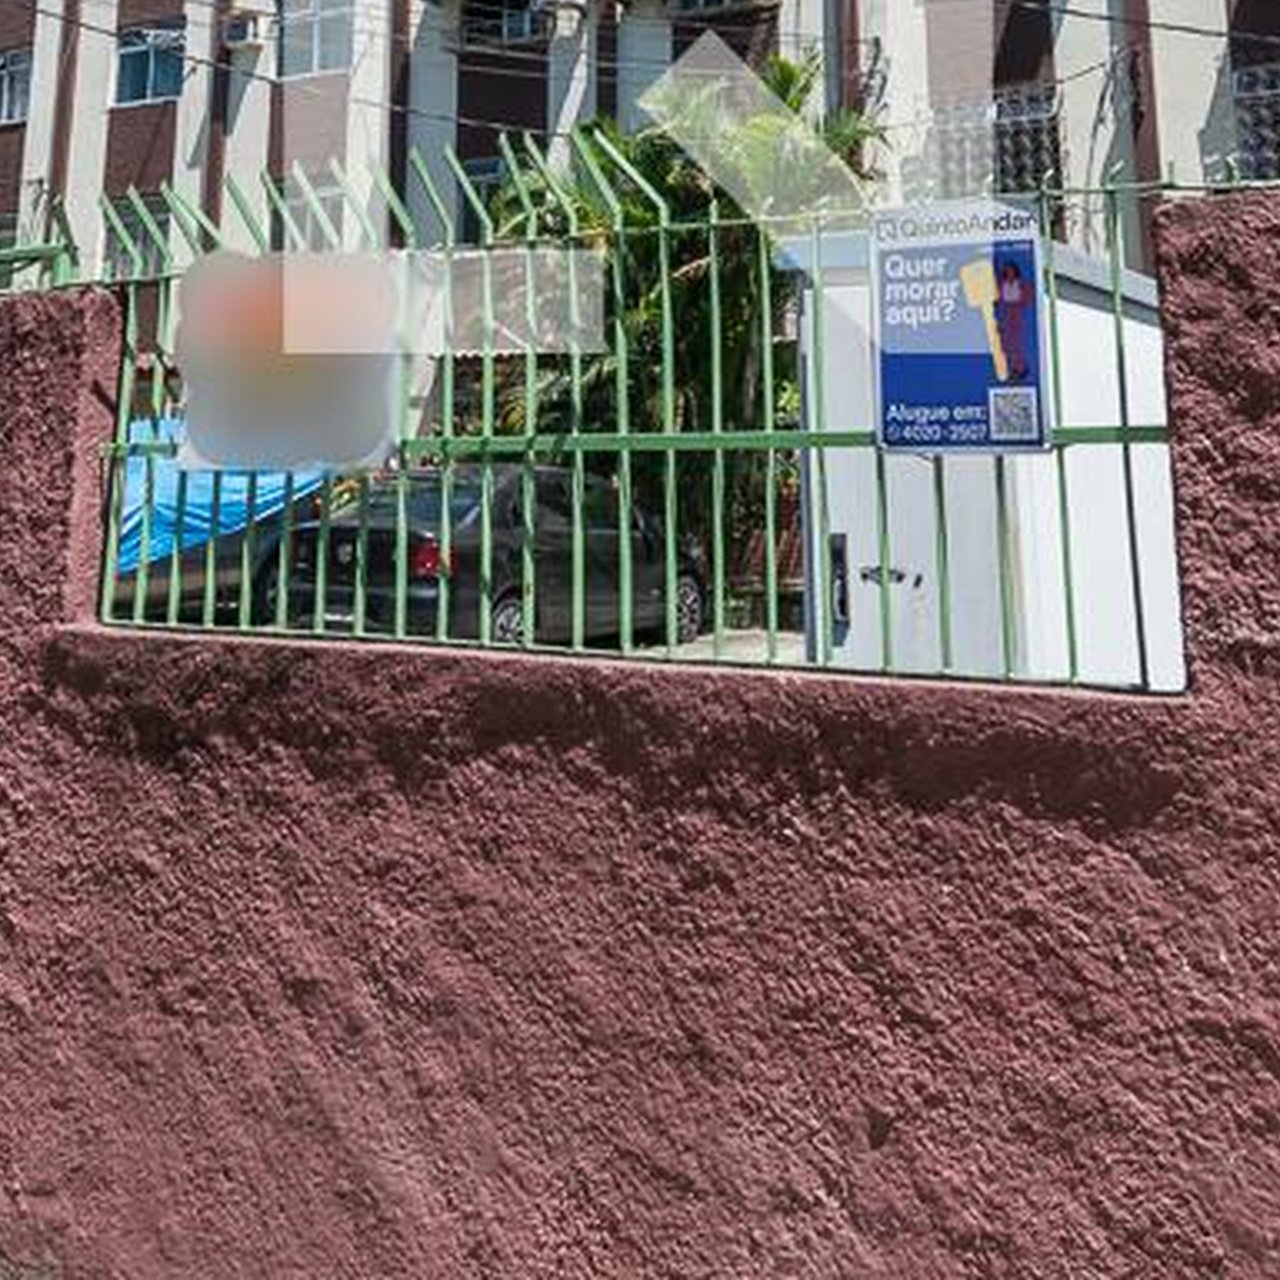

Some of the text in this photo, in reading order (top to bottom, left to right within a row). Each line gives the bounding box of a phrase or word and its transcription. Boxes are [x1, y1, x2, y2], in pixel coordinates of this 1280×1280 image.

[900, 213, 1037, 238] QuintoAndar
[885, 255, 947, 280] Quer
[885, 281, 959, 301] morar
[885, 300, 956, 328] aqui?
[886, 403, 987, 424] Alugue em:
